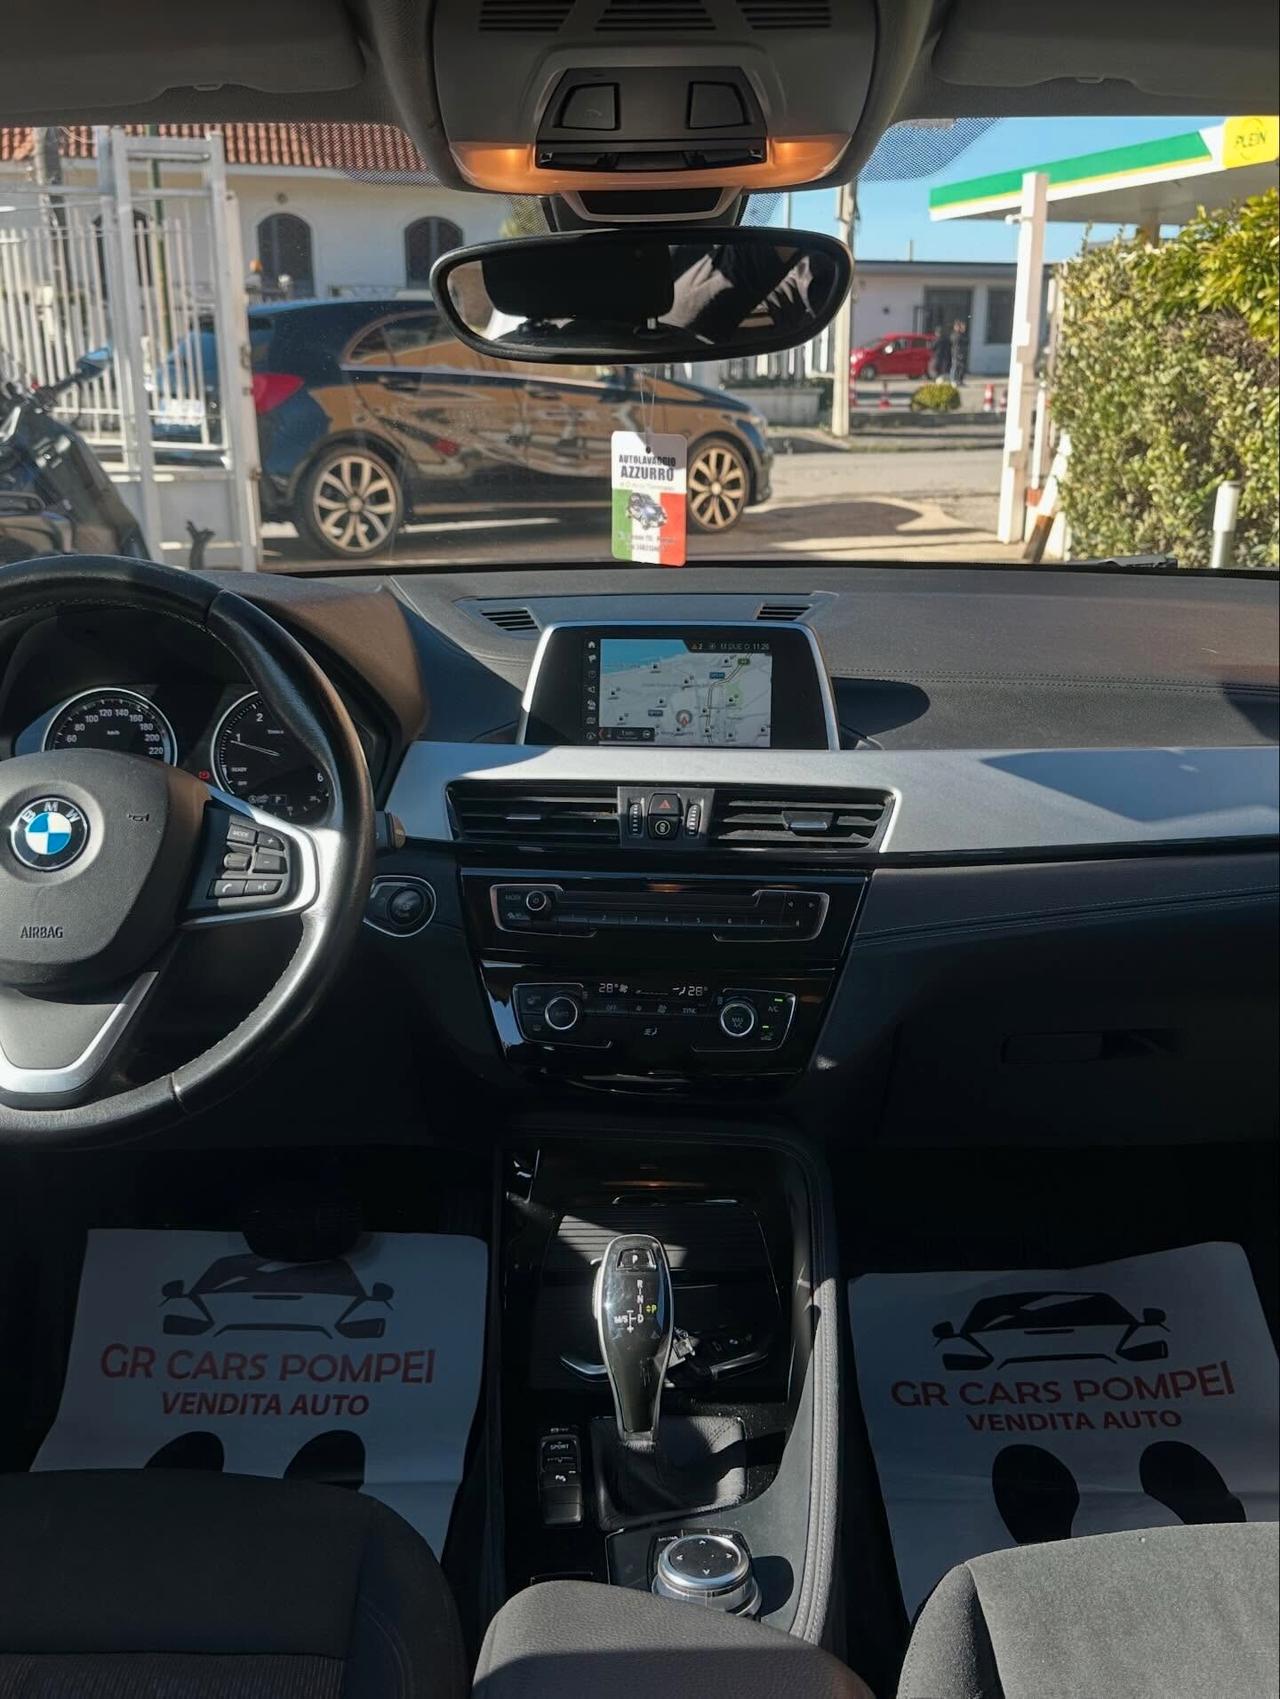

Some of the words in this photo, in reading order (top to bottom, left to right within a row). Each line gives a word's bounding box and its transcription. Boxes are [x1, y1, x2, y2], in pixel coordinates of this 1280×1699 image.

[618, 454, 677, 468] AUTOLAVAGGIO
[620, 465, 675, 481] AZZURRO
[99, 708, 113, 717] 120
[115, 708, 129, 717] 140
[256, 712, 263, 722] 2
[85, 715, 99, 723] 100
[129, 714, 144, 722] 160
[74, 723, 86, 731] 80
[140, 723, 154, 731] 180
[66, 735, 78, 743] 60
[144, 734, 160, 742] 200
[148, 747, 164, 755] 220
[317, 772, 324, 782] 6
[21, 801, 81, 823] BMW
[20, 925, 64, 939] AIRBAG
[632, 1254, 639, 1264] P
[637, 1279, 643, 1288] R
[637, 1295, 644, 1304] N
[637, 1314, 644, 1324] D
[100, 1342, 157, 1379] GR
[166, 1348, 269, 1381] CARS
[278, 1348, 436, 1384] POMPEI
[891, 1379, 950, 1408] GR
[958, 1379, 1062, 1406] CARS
[1072, 1360, 1236, 1402] POMPEI
[161, 1391, 282, 1416] VENDITA
[289, 1393, 370, 1416] AUTO
[965, 1410, 1096, 1432] VENDITA
[1102, 1409, 1183, 1429] AUTO
